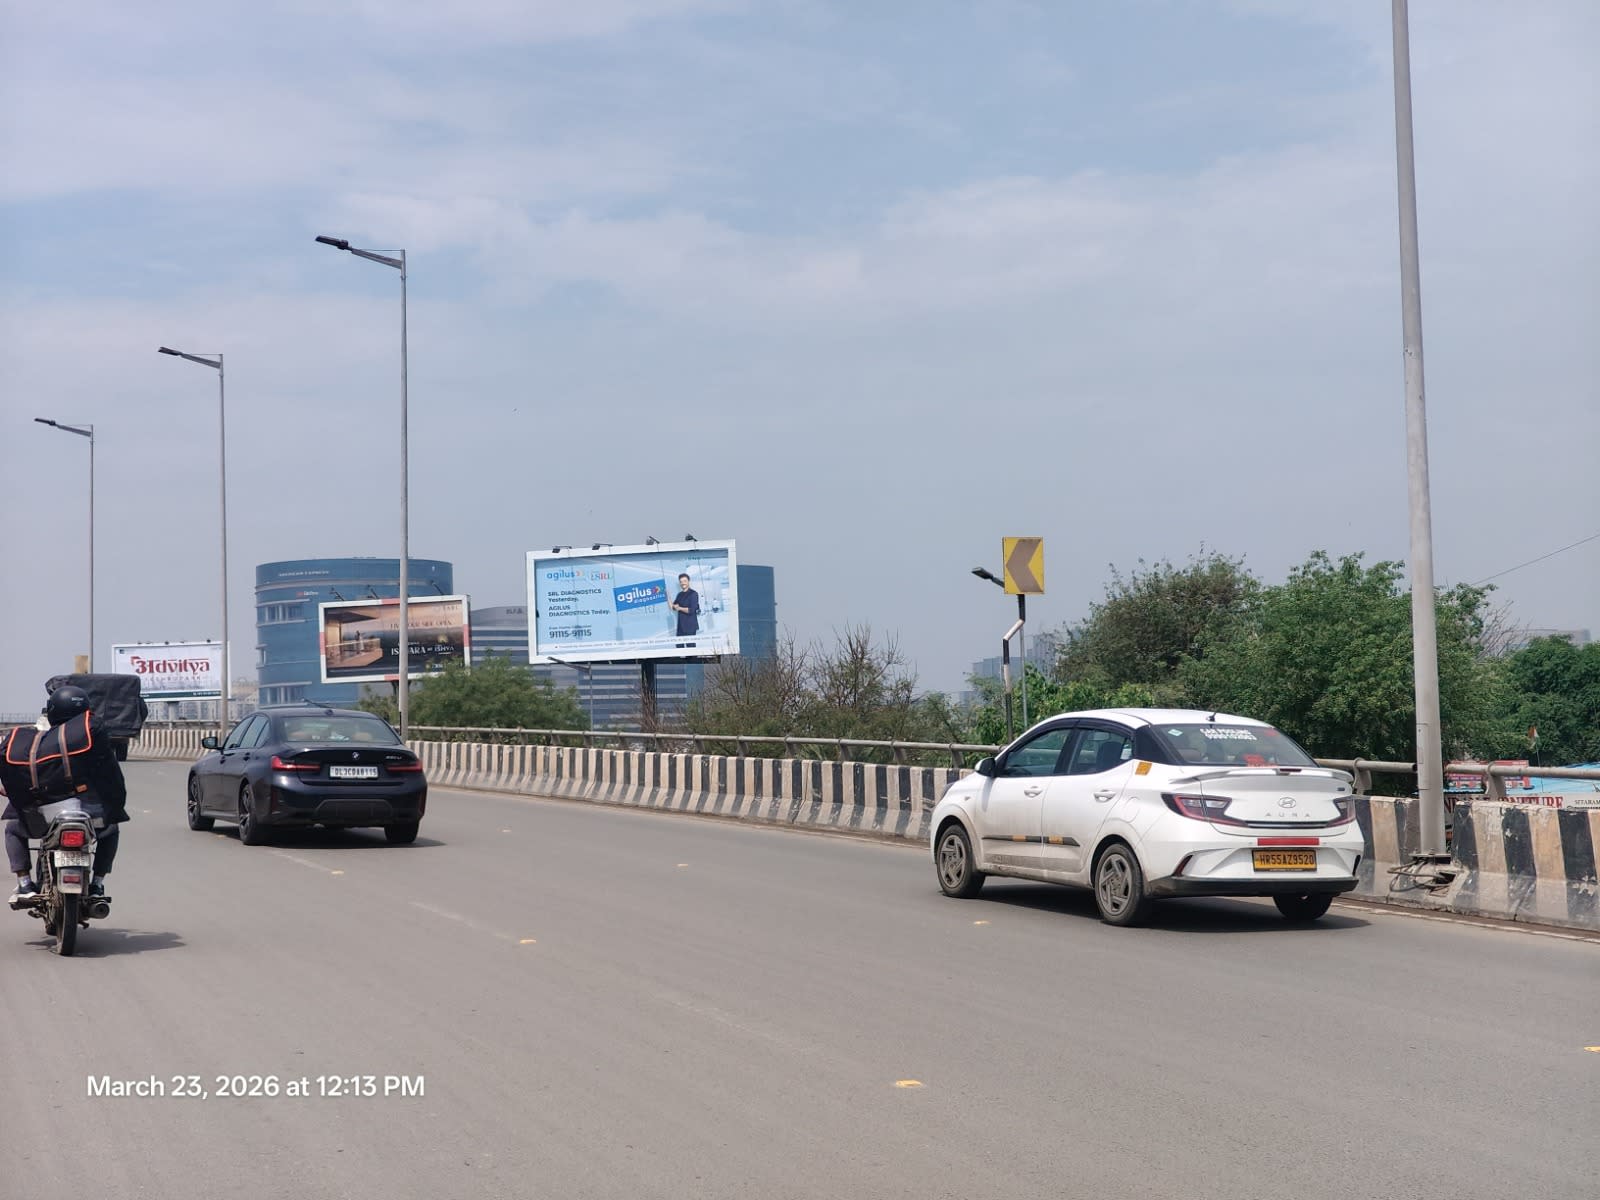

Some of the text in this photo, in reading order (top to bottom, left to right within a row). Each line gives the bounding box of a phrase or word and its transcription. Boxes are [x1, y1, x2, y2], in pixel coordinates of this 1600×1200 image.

[546, 569, 575, 580] agilus
[560, 588, 602, 596] DIAGNOSTICS
[617, 587, 652, 603] agilus
[549, 630, 592, 639] 91115-91115
[1259, 854, 1315, 865] HR55AZ9520
